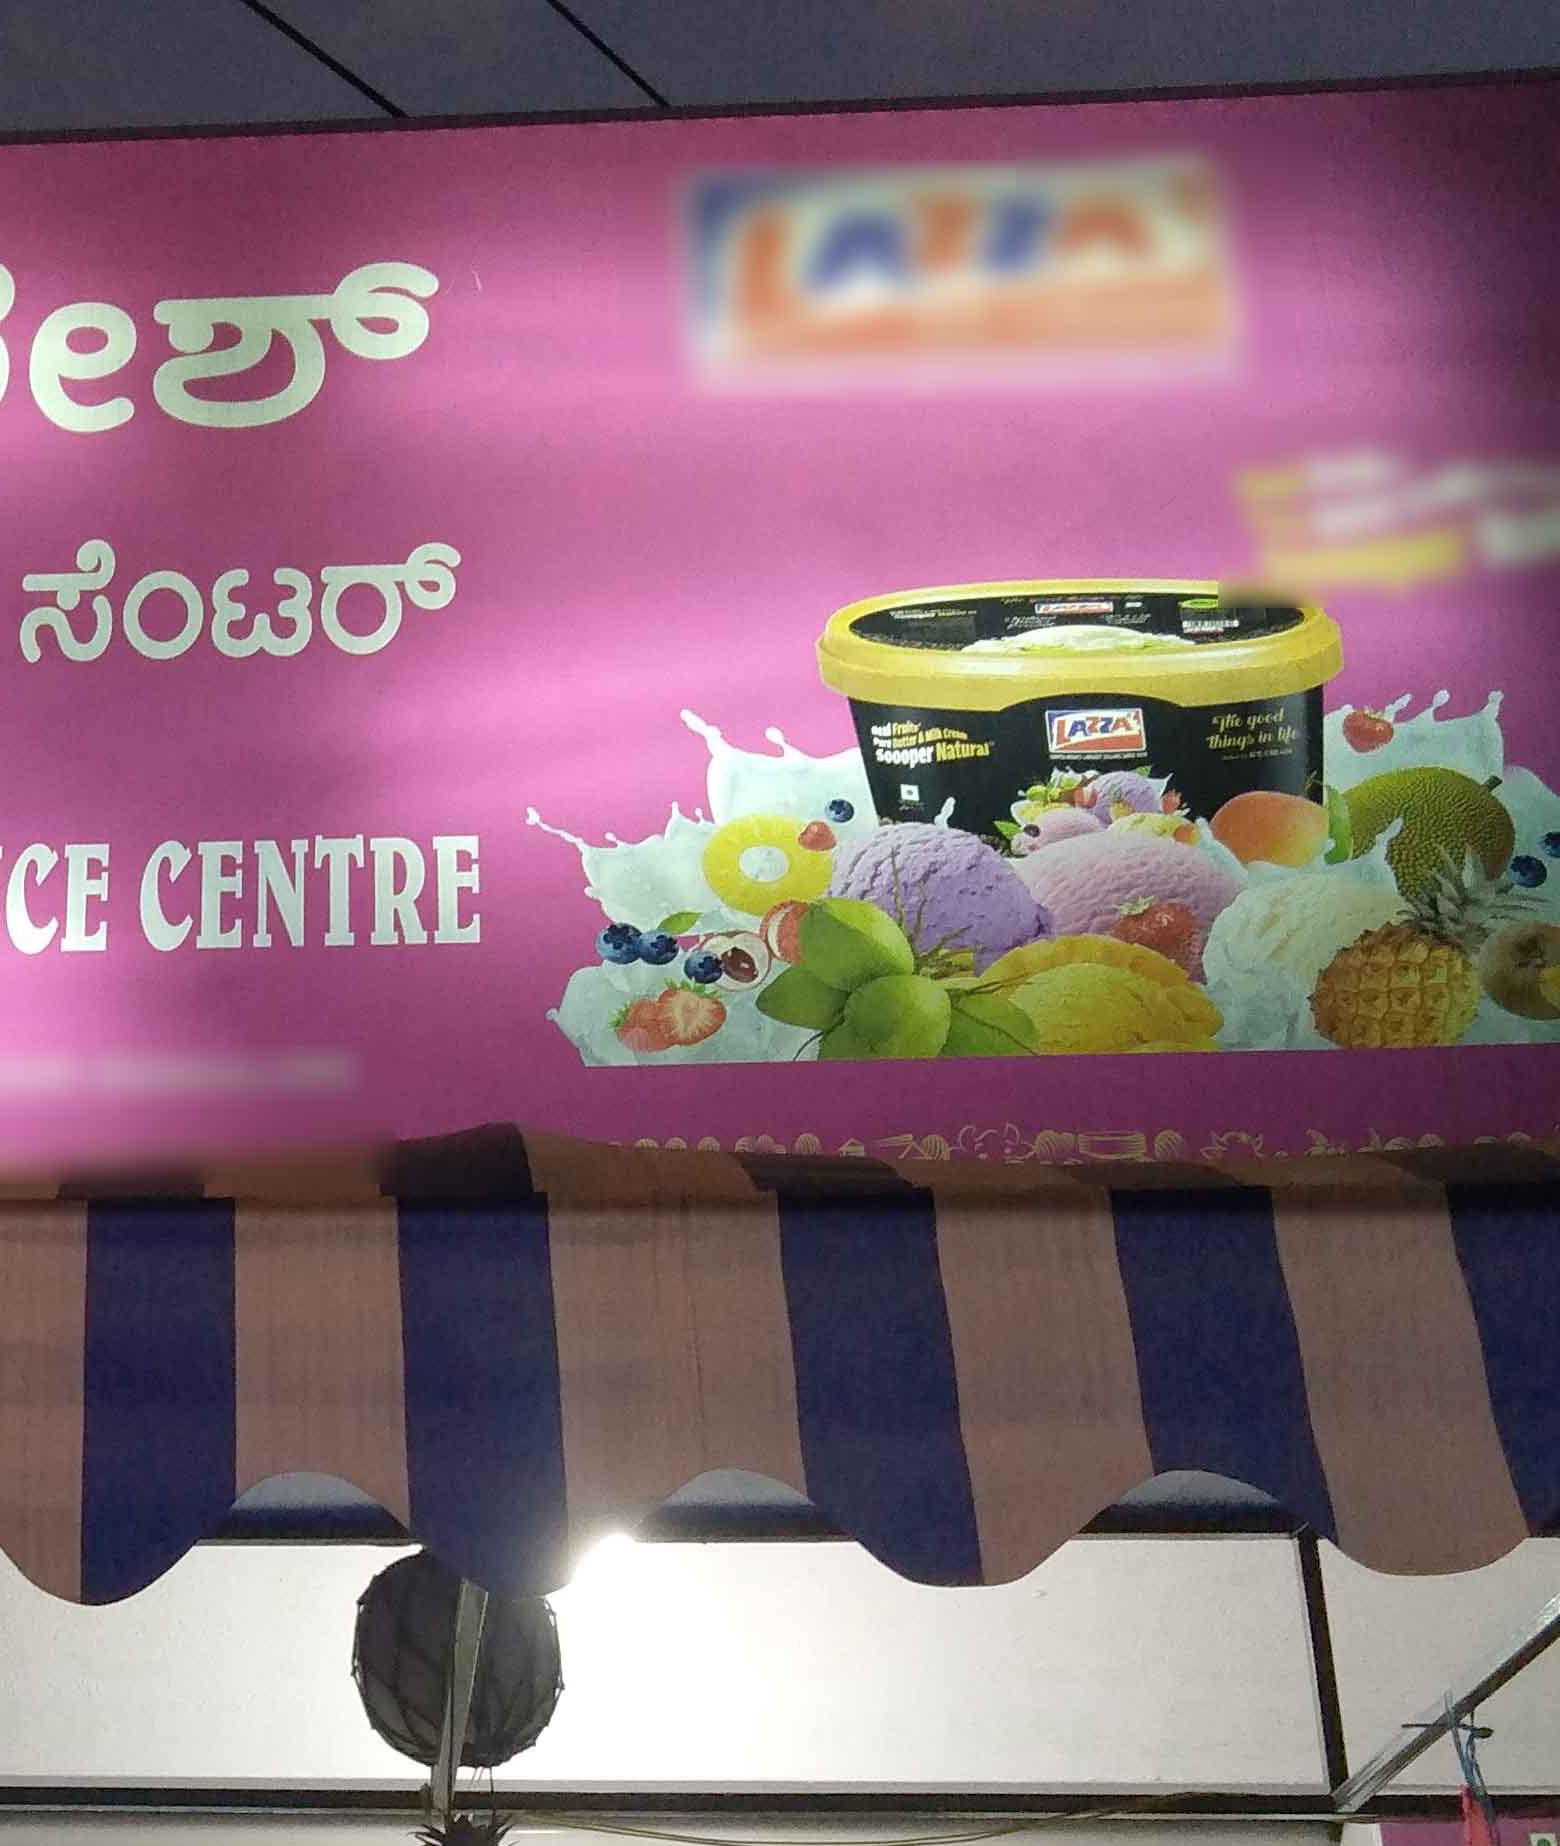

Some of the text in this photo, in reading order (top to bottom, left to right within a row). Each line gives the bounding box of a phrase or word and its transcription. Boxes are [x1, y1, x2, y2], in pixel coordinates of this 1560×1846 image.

[19, 539, 461, 662] ಸೆಂಟರ್
[935, 741, 991, 763] Natural
[140, 835, 481, 952] CENTRE
